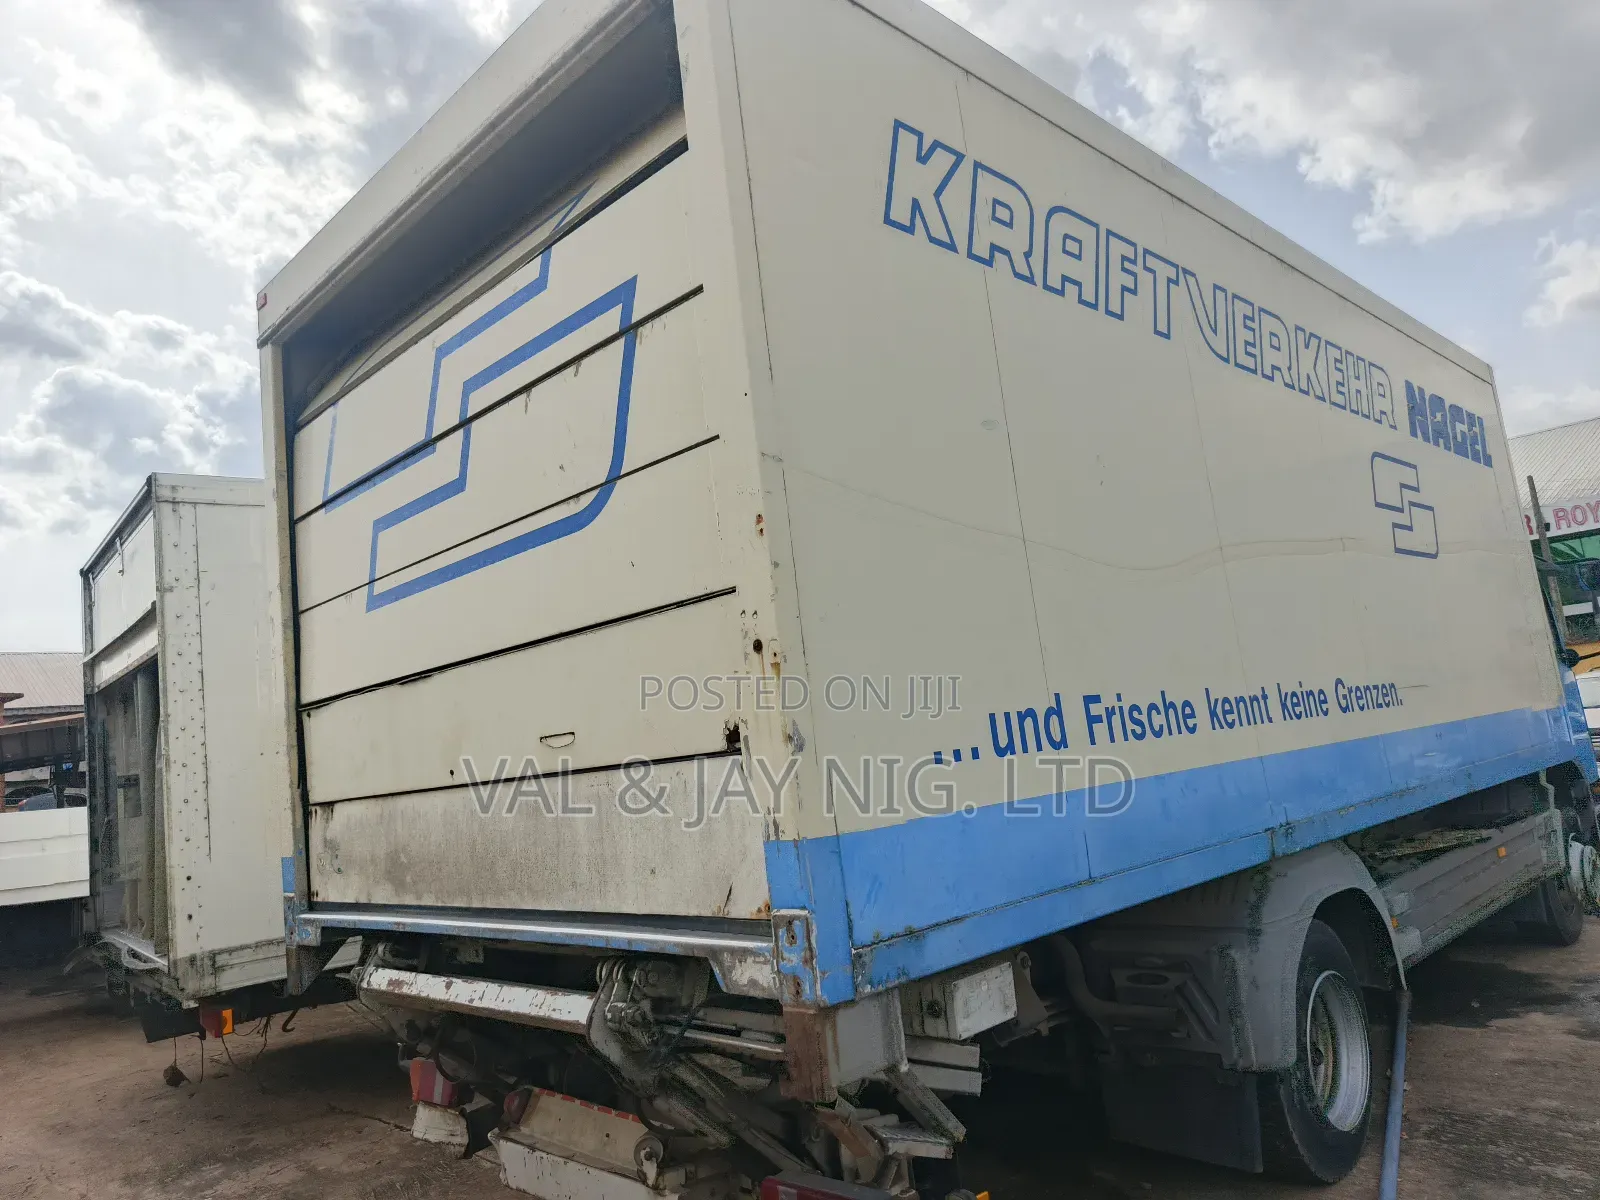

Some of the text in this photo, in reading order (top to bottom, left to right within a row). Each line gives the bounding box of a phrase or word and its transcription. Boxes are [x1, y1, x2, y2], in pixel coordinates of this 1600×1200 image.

[883, 118, 1493, 468] KRAFTVERKEHR NAGEL
[1082, 690, 1198, 745] Frische
[1204, 686, 1273, 731] kennt
[1276, 681, 1329, 721] keine
[1334, 677, 1404, 714] Grenzen.
